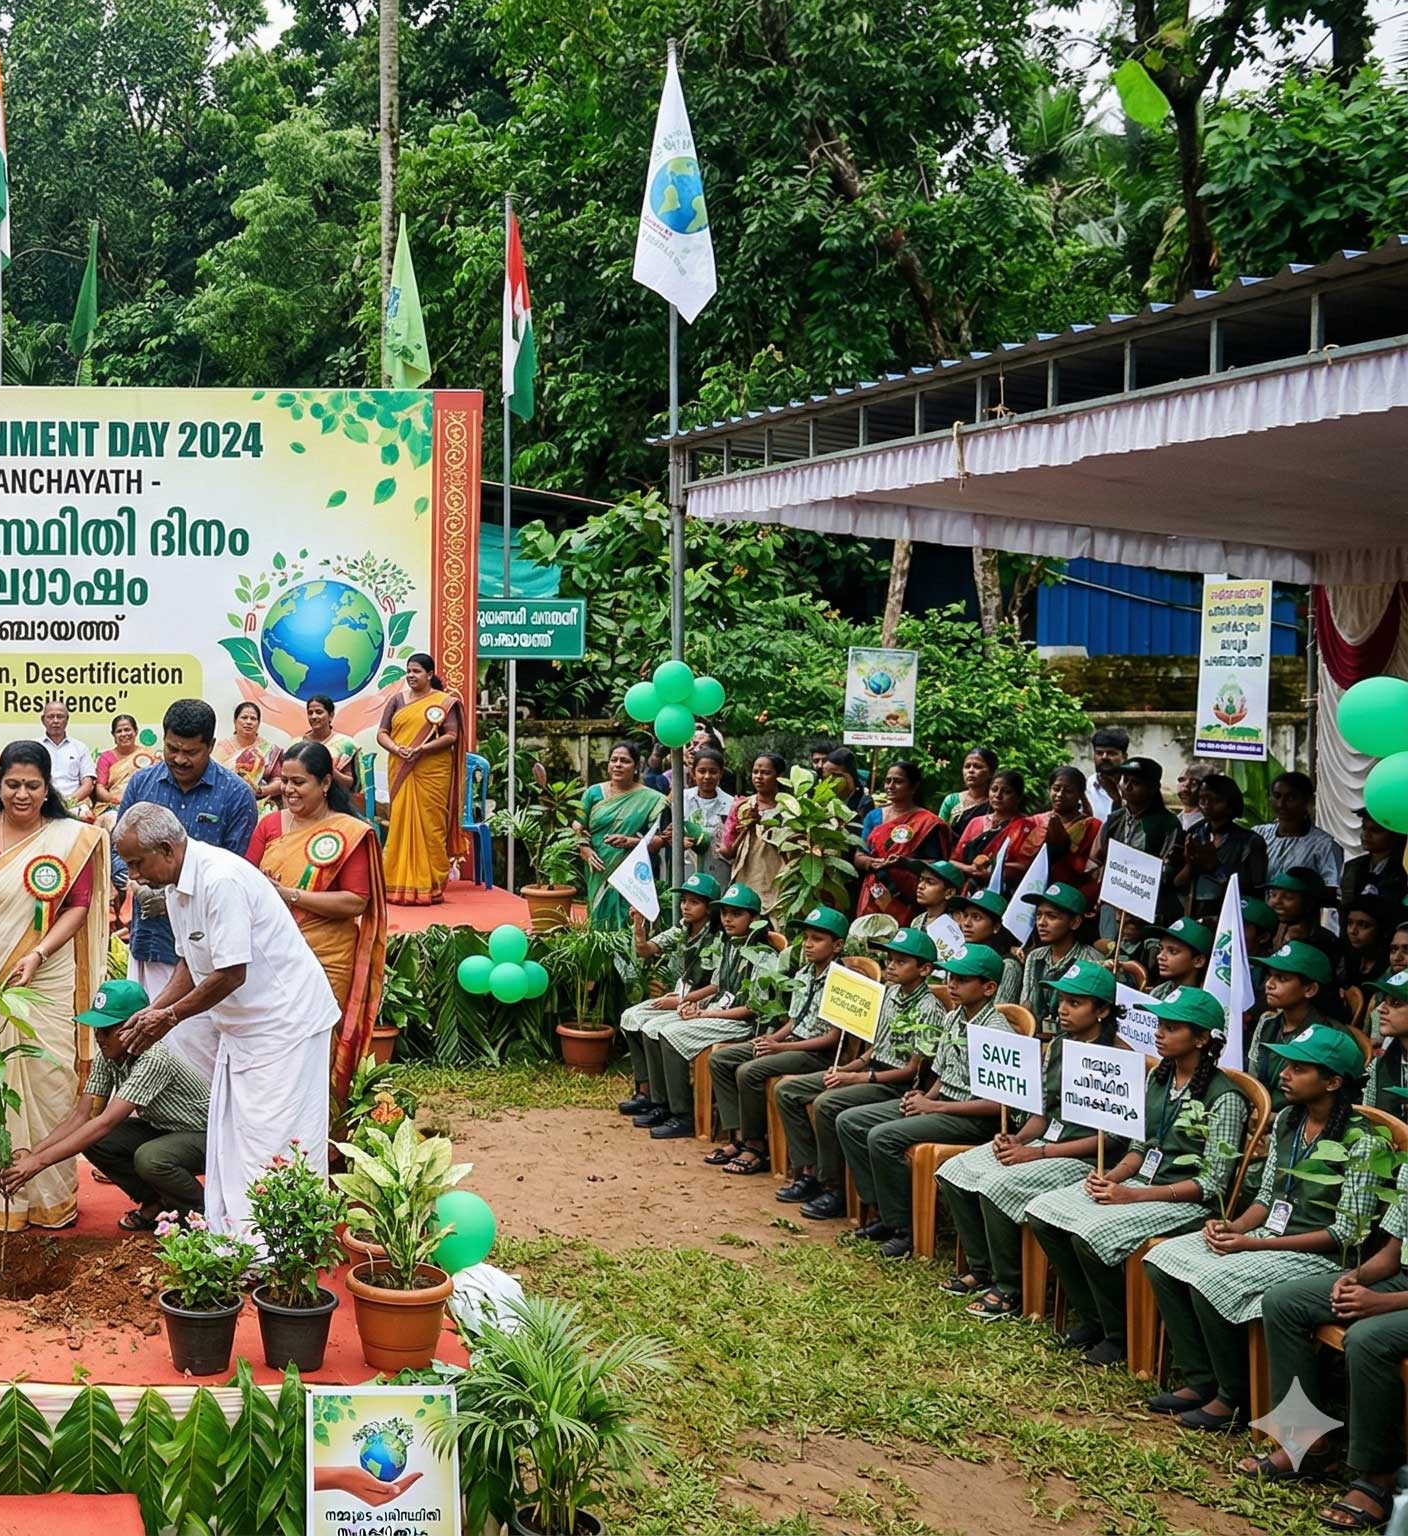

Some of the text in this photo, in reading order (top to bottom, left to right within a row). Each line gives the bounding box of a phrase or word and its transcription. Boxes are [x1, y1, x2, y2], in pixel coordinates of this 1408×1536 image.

[109, 421, 170, 458] DAY
[178, 421, 264, 458] 2024
[150, 506, 250, 556] ദിനം
[25, 662, 183, 685] Desertification
[982, 1043, 1021, 1069] SAVE
[977, 1066, 1027, 1097] EARTH
